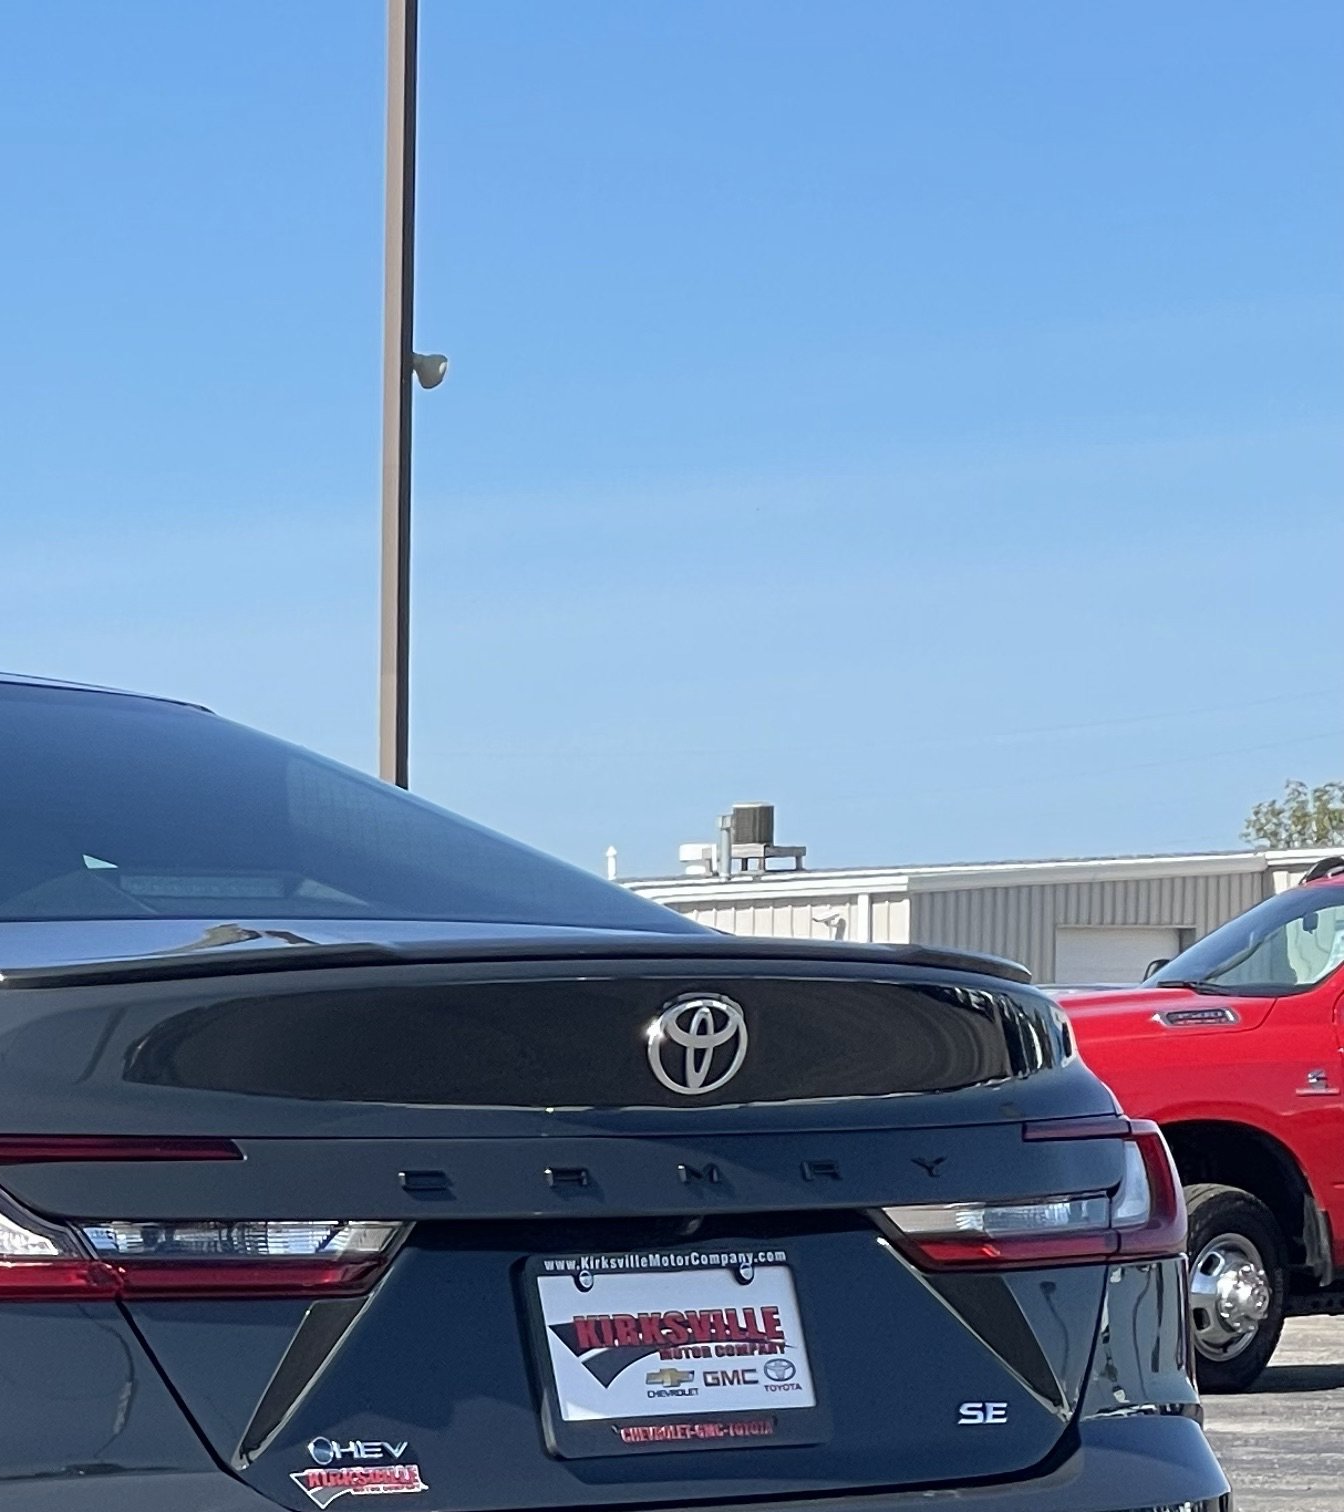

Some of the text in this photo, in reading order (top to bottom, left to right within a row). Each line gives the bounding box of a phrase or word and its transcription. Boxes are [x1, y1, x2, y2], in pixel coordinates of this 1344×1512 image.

[543, 1250, 787, 1271] www.KirksvilleMotorCompany.com
[572, 1306, 786, 1350] KIRKSVILLE
[659, 1341, 786, 1361] MOTOR COMPANY
[702, 1368, 759, 1387] GMC
[763, 1382, 803, 1392] TOYOTA
[647, 1387, 699, 1399] CHEVROLET
[958, 1402, 1008, 1424] SE
